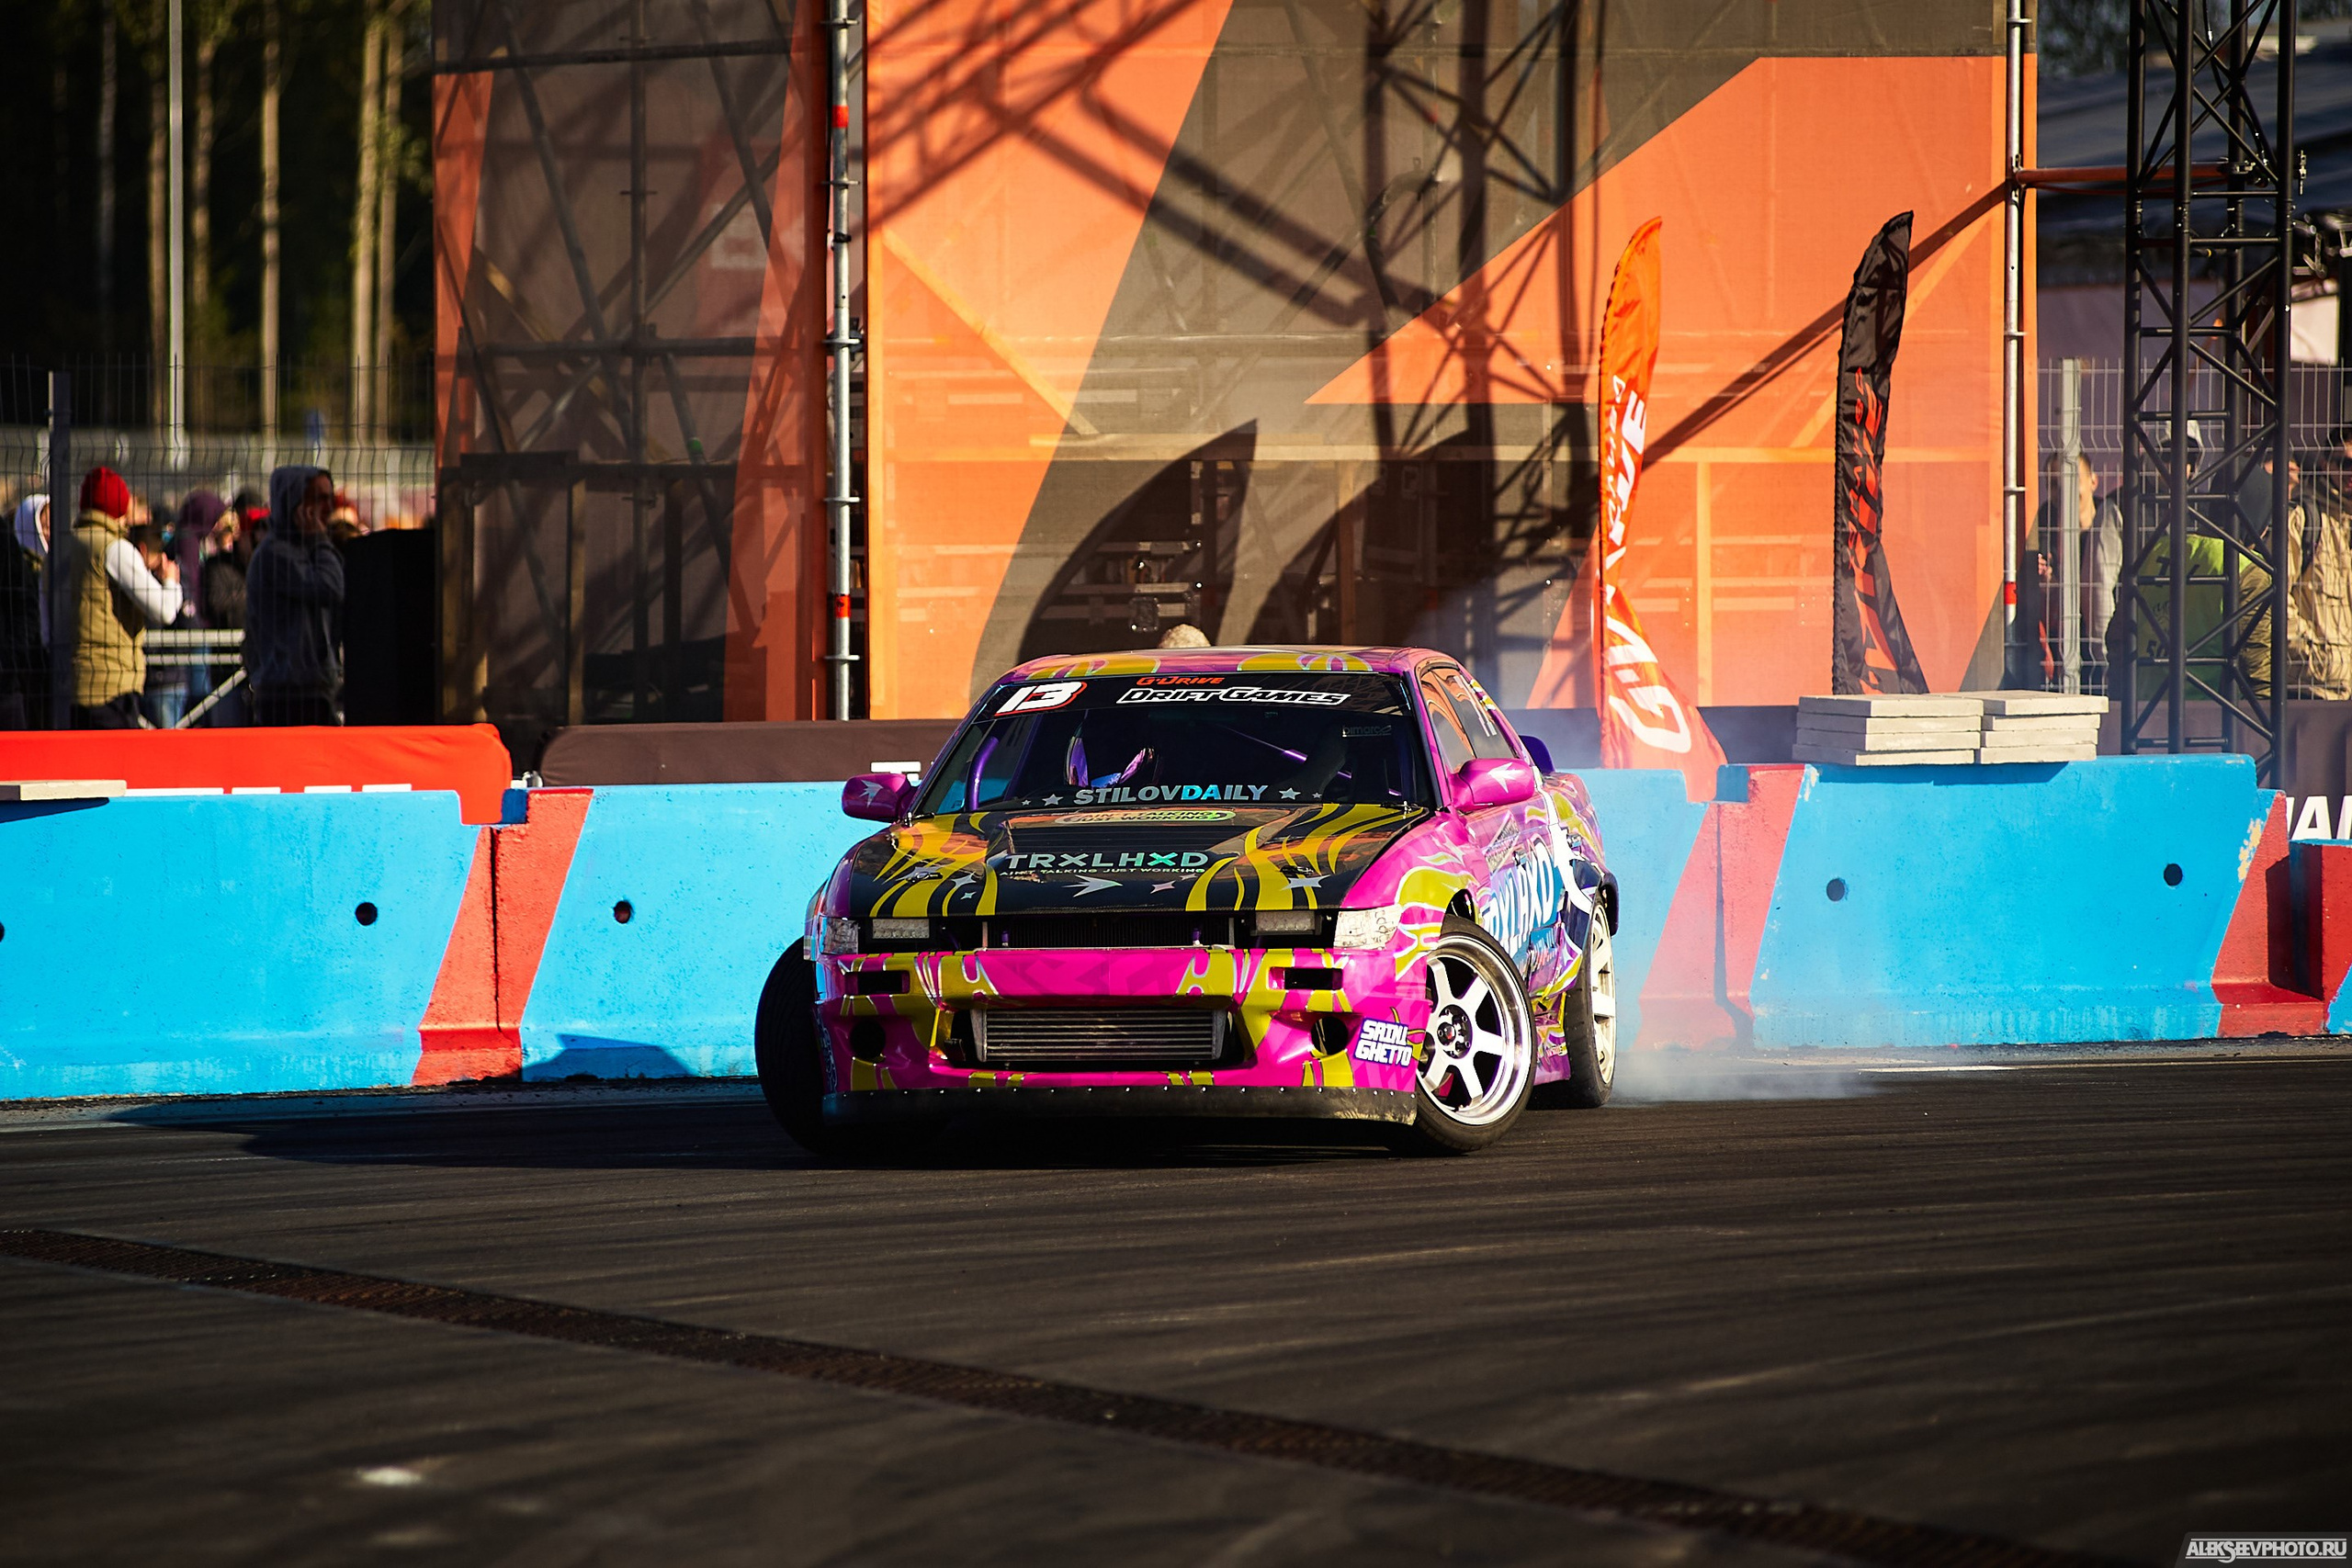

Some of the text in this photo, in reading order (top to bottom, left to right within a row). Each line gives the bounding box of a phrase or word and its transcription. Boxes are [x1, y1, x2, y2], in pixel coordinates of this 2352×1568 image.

[996, 681, 1084, 715] 13
[1120, 687, 1351, 705] DRIFT GAMES
[1073, 784, 1269, 805] STILOVDAILY
[1007, 852, 1209, 869] TRXLHXD
[1354, 1039, 1413, 1066] GHETTO
